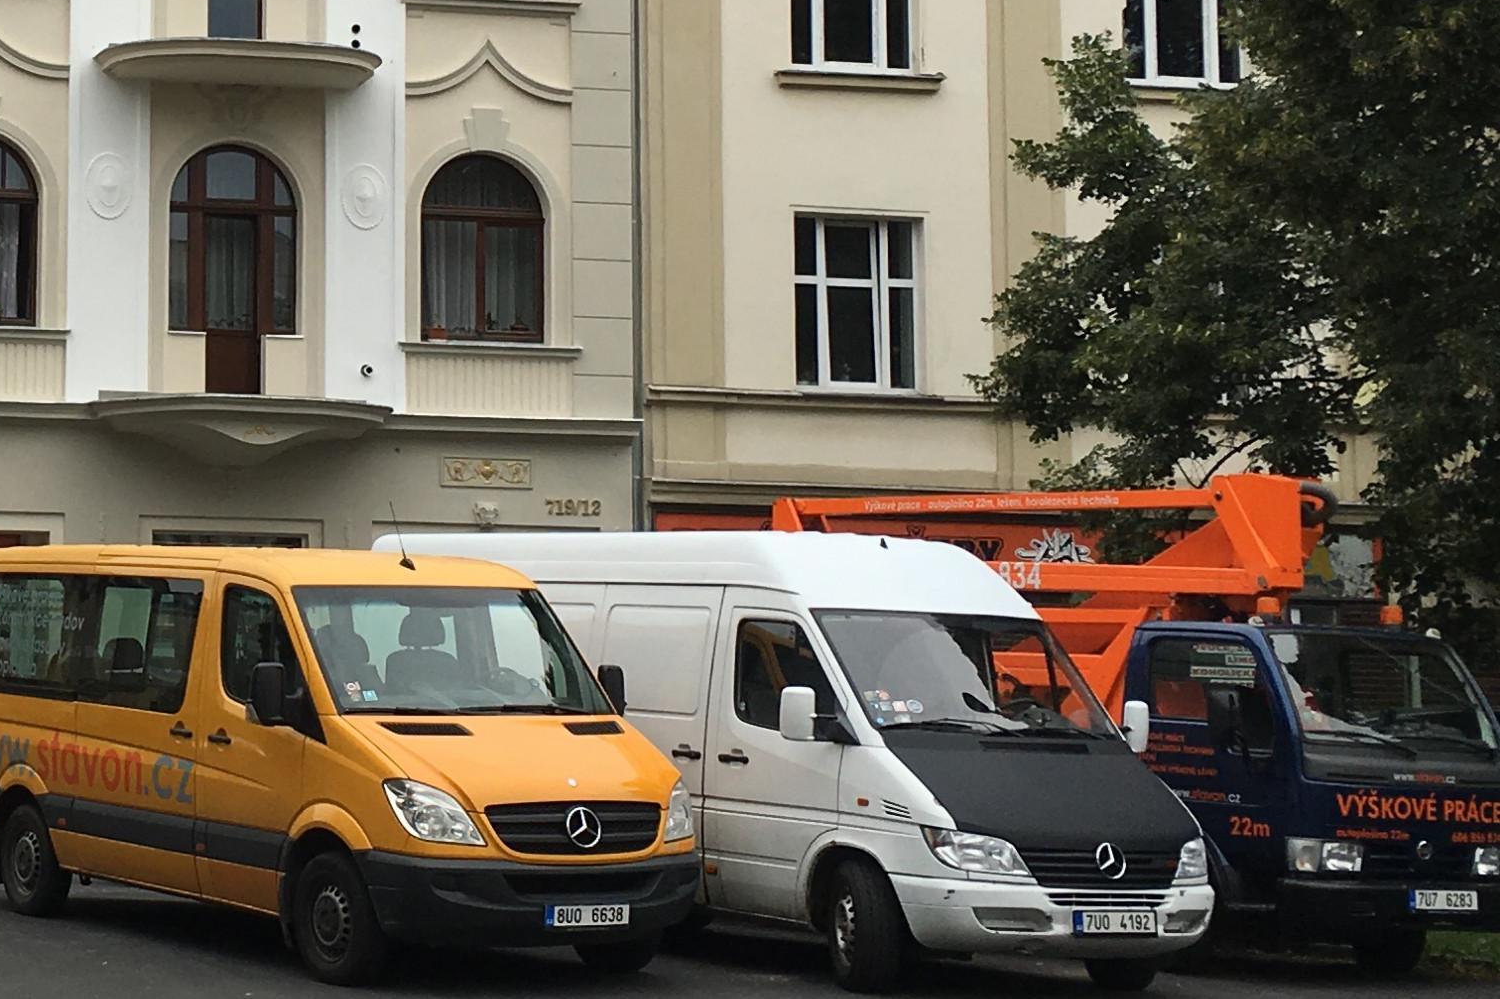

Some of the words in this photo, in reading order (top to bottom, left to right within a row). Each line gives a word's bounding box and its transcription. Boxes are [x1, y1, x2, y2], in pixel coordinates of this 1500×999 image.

[545, 498, 602, 517] 719/12
[1336, 788, 1437, 821] VÝŠKOVÉ
[1443, 793, 1500, 824] PRÁCE
[1230, 816, 1271, 837] 22m
[1417, 892, 1438, 907] 7U7
[1446, 893, 1473, 908] 6283
[591, 906, 624, 923] 6638
[1120, 914, 1151, 931] 4192
